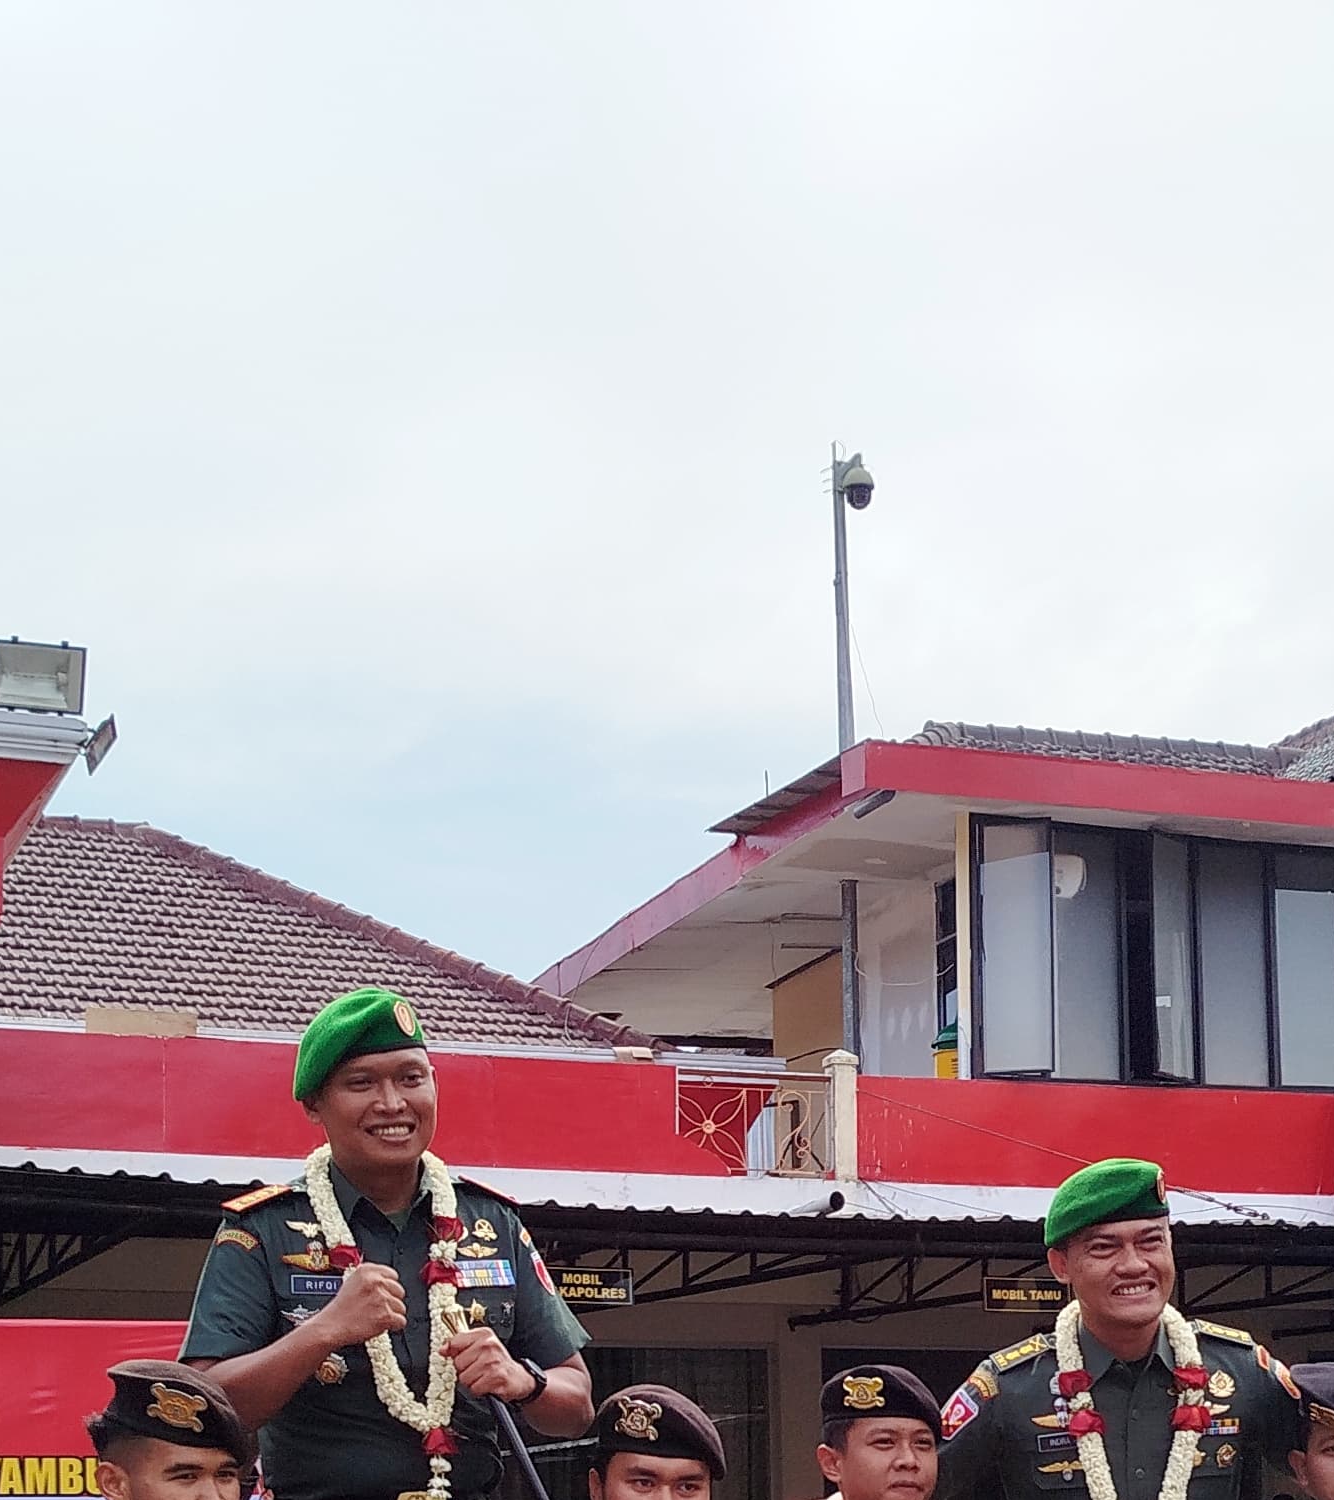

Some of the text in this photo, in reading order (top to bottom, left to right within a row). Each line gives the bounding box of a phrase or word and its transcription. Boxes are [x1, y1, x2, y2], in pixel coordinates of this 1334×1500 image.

[562, 1273, 603, 1285] MOBIL
[556, 1286, 627, 1299] KAPOLRES
[992, 1289, 1062, 1300] MOBIL TAMU
